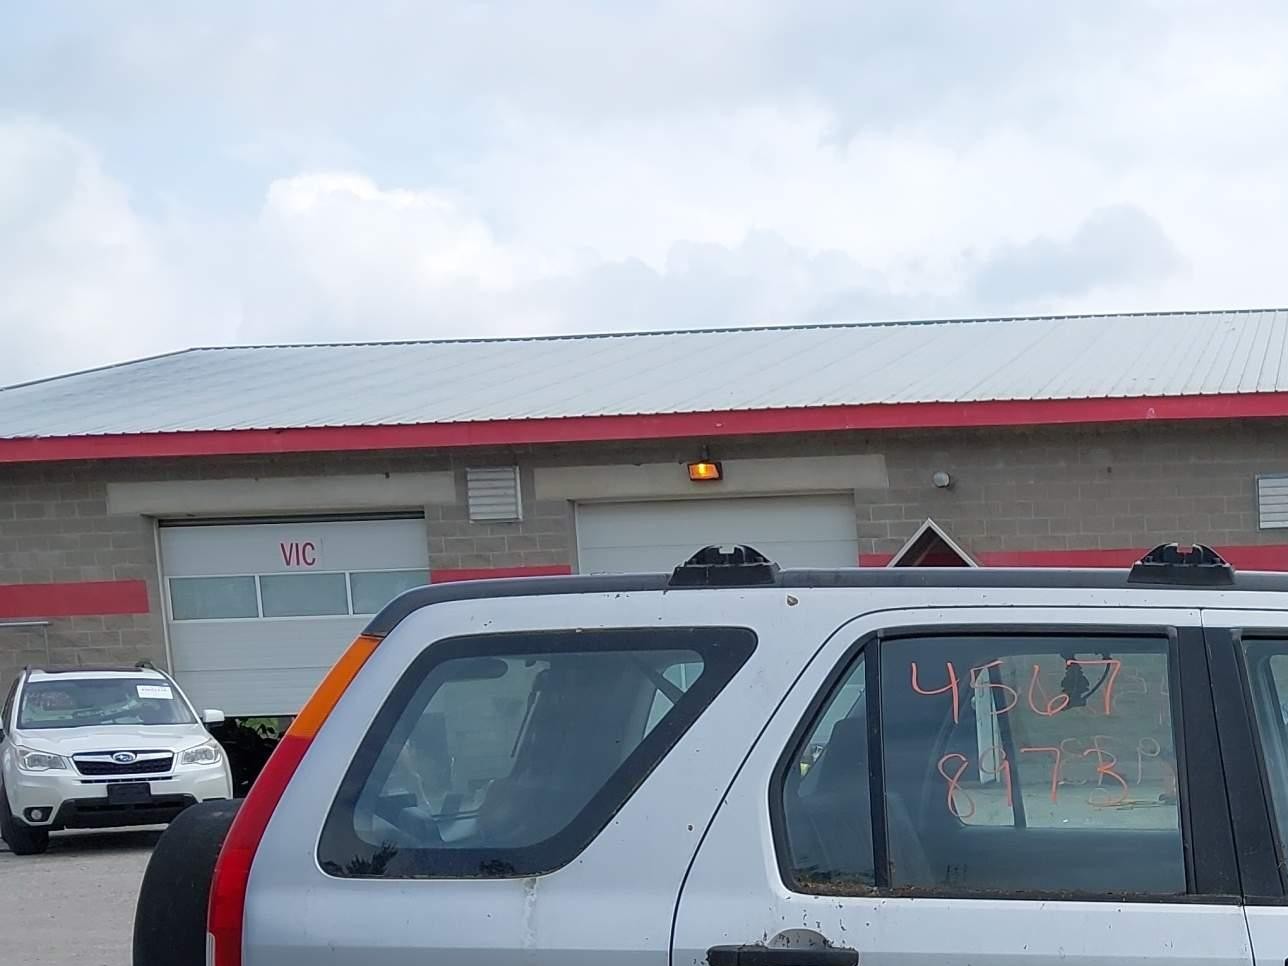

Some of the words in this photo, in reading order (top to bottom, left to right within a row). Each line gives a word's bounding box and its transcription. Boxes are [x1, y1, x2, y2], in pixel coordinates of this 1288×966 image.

[280, 542, 316, 566] VIC
[911, 659, 1121, 724] 4567
[938, 747, 1129, 818] 8973
